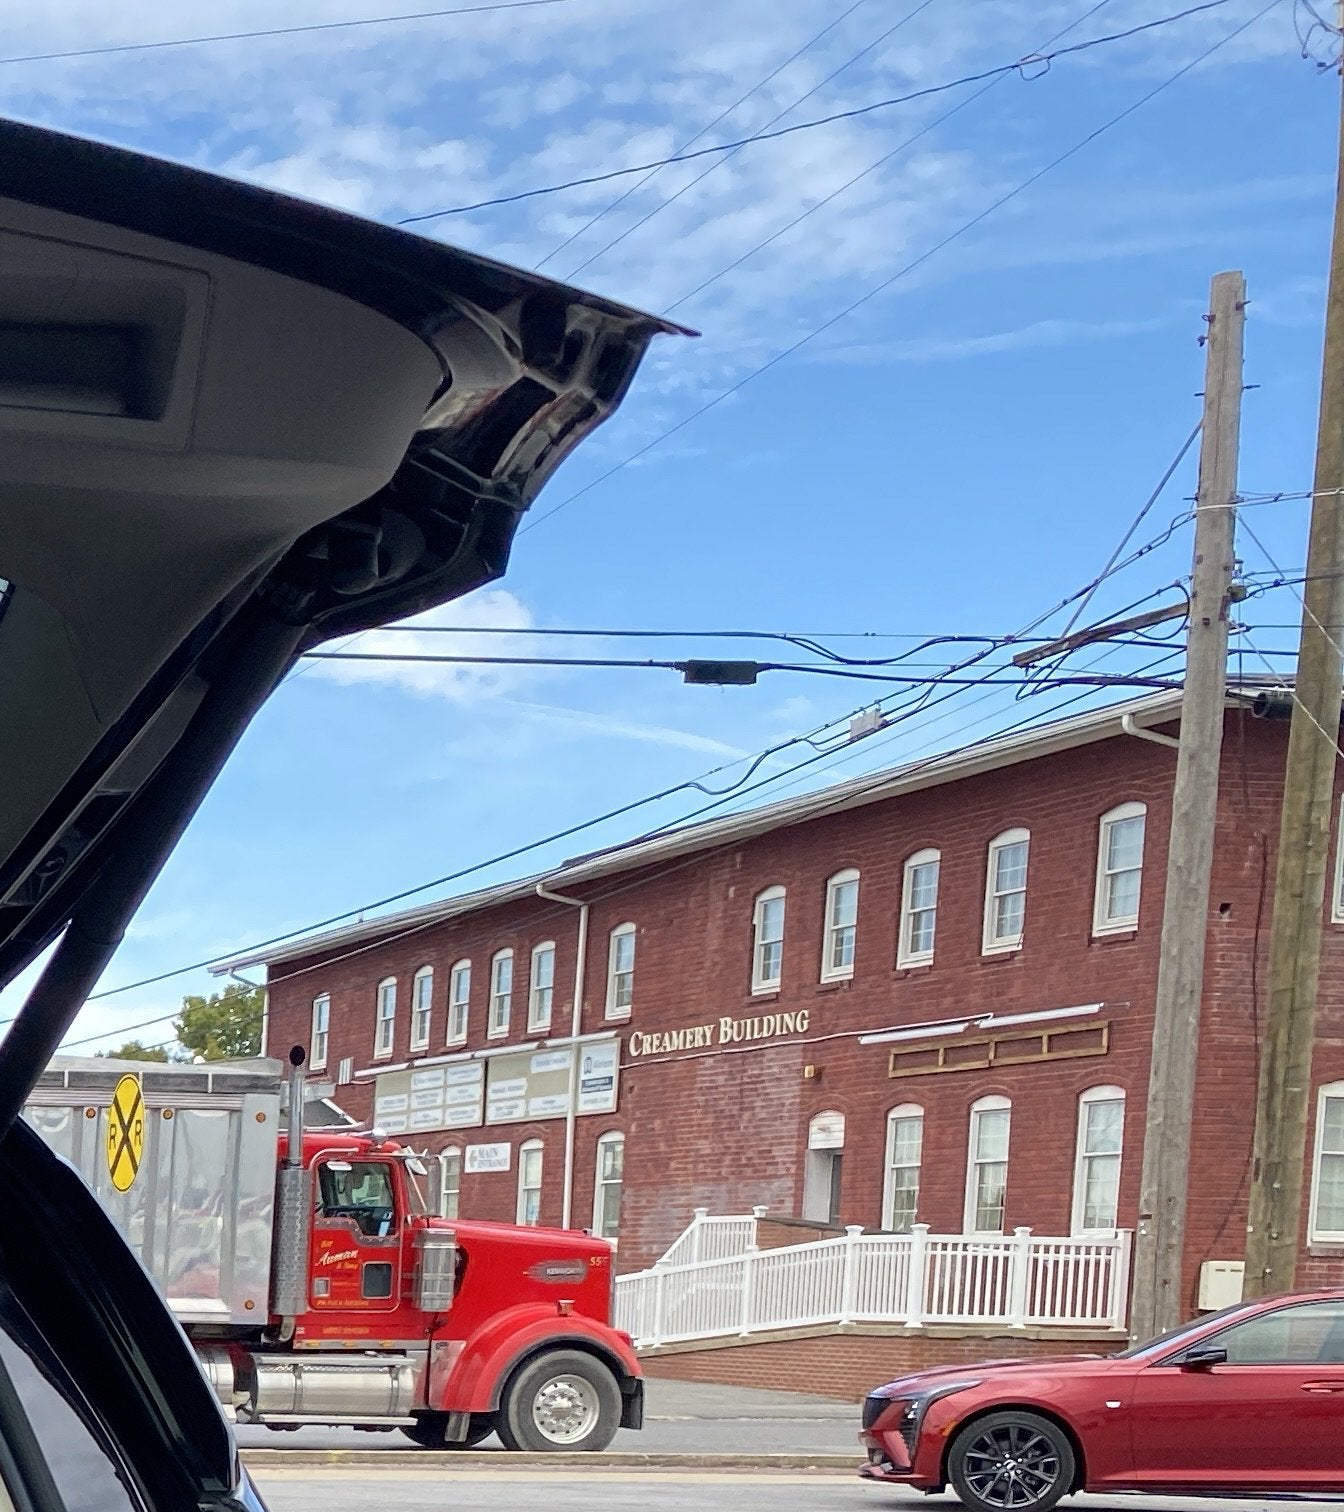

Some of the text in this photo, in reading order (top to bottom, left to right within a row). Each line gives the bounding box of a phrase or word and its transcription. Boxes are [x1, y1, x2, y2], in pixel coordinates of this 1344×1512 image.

[629, 1009, 810, 1057] CREAMERY BUILDING
[109, 1119, 142, 1150] R R
[478, 1147, 498, 1159] MAIN
